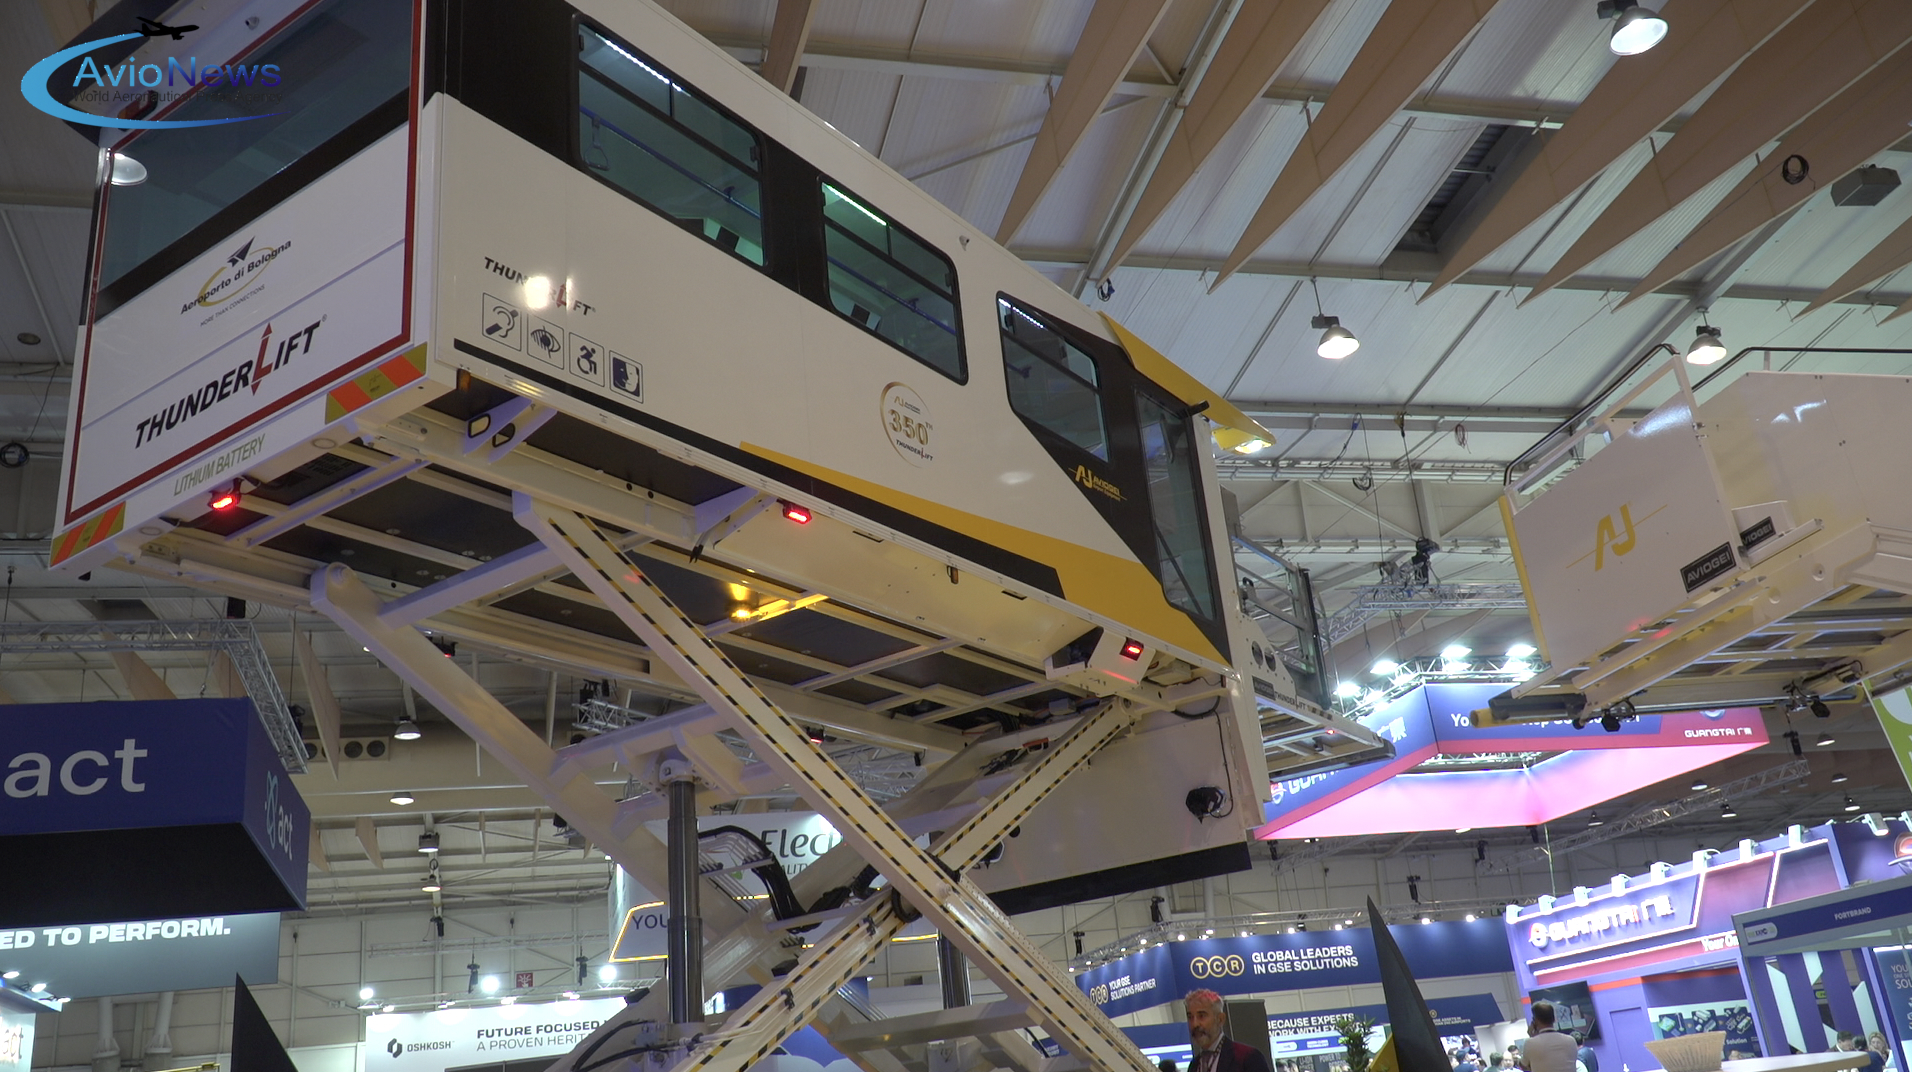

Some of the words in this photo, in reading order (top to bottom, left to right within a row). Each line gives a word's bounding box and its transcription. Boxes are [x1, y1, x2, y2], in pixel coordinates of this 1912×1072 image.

[180, 278, 231, 315] Aeroporto
[234, 267, 245, 281] di
[247, 240, 292, 273] Bologna
[200, 315, 214, 327] MORE
[215, 306, 229, 318] THAN
[229, 284, 266, 310] CONNECTIONS
[134, 319, 321, 450] THUNDERLIFT
[896, 439, 933, 461] THUNDERLIFT
[173, 461, 215, 497] LITHIUM
[215, 433, 266, 475] BATTERY
[1742, 523, 1773, 545] VIOGEI
[1686, 551, 1732, 584] AVIOGEI
[1451, 713, 1471, 728] Yo
[1684, 728, 1735, 738] GUANGTAI
[3, 738, 149, 799] act
[277, 804, 294, 861] act
[1549, 904, 1640, 941] GUANGTAI
[1834, 906, 1872, 921] FORTBRAND
[43, 927, 82, 947] TO
[88, 917, 231, 944] PERFORM.
[1251, 948, 1299, 963] GLOBAL
[1300, 945, 1354, 959] LEADERS
[1700, 937, 1724, 952] Your
[1193, 956, 1242, 977] TCR
[1253, 963, 1266, 975] IN
[1267, 961, 1292, 974] GSE
[1293, 956, 1359, 971] SOLUTIONS
[1108, 977, 1121, 988] YOUR
[1121, 975, 1131, 986] GSE
[1110, 984, 1134, 1001] SOLUTIONS
[1134, 978, 1156, 993] PARTNER
[477, 1026, 532, 1039] FUTURE
[536, 1020, 600, 1035] FOCUSED
[407, 1041, 451, 1053] OSHKOSH
[476, 1040, 487, 1052] A
[490, 1036, 544, 1050] PROVEN
[547, 1033, 587, 1046] HERIT
[1726, 1037, 1748, 1046] Solution
